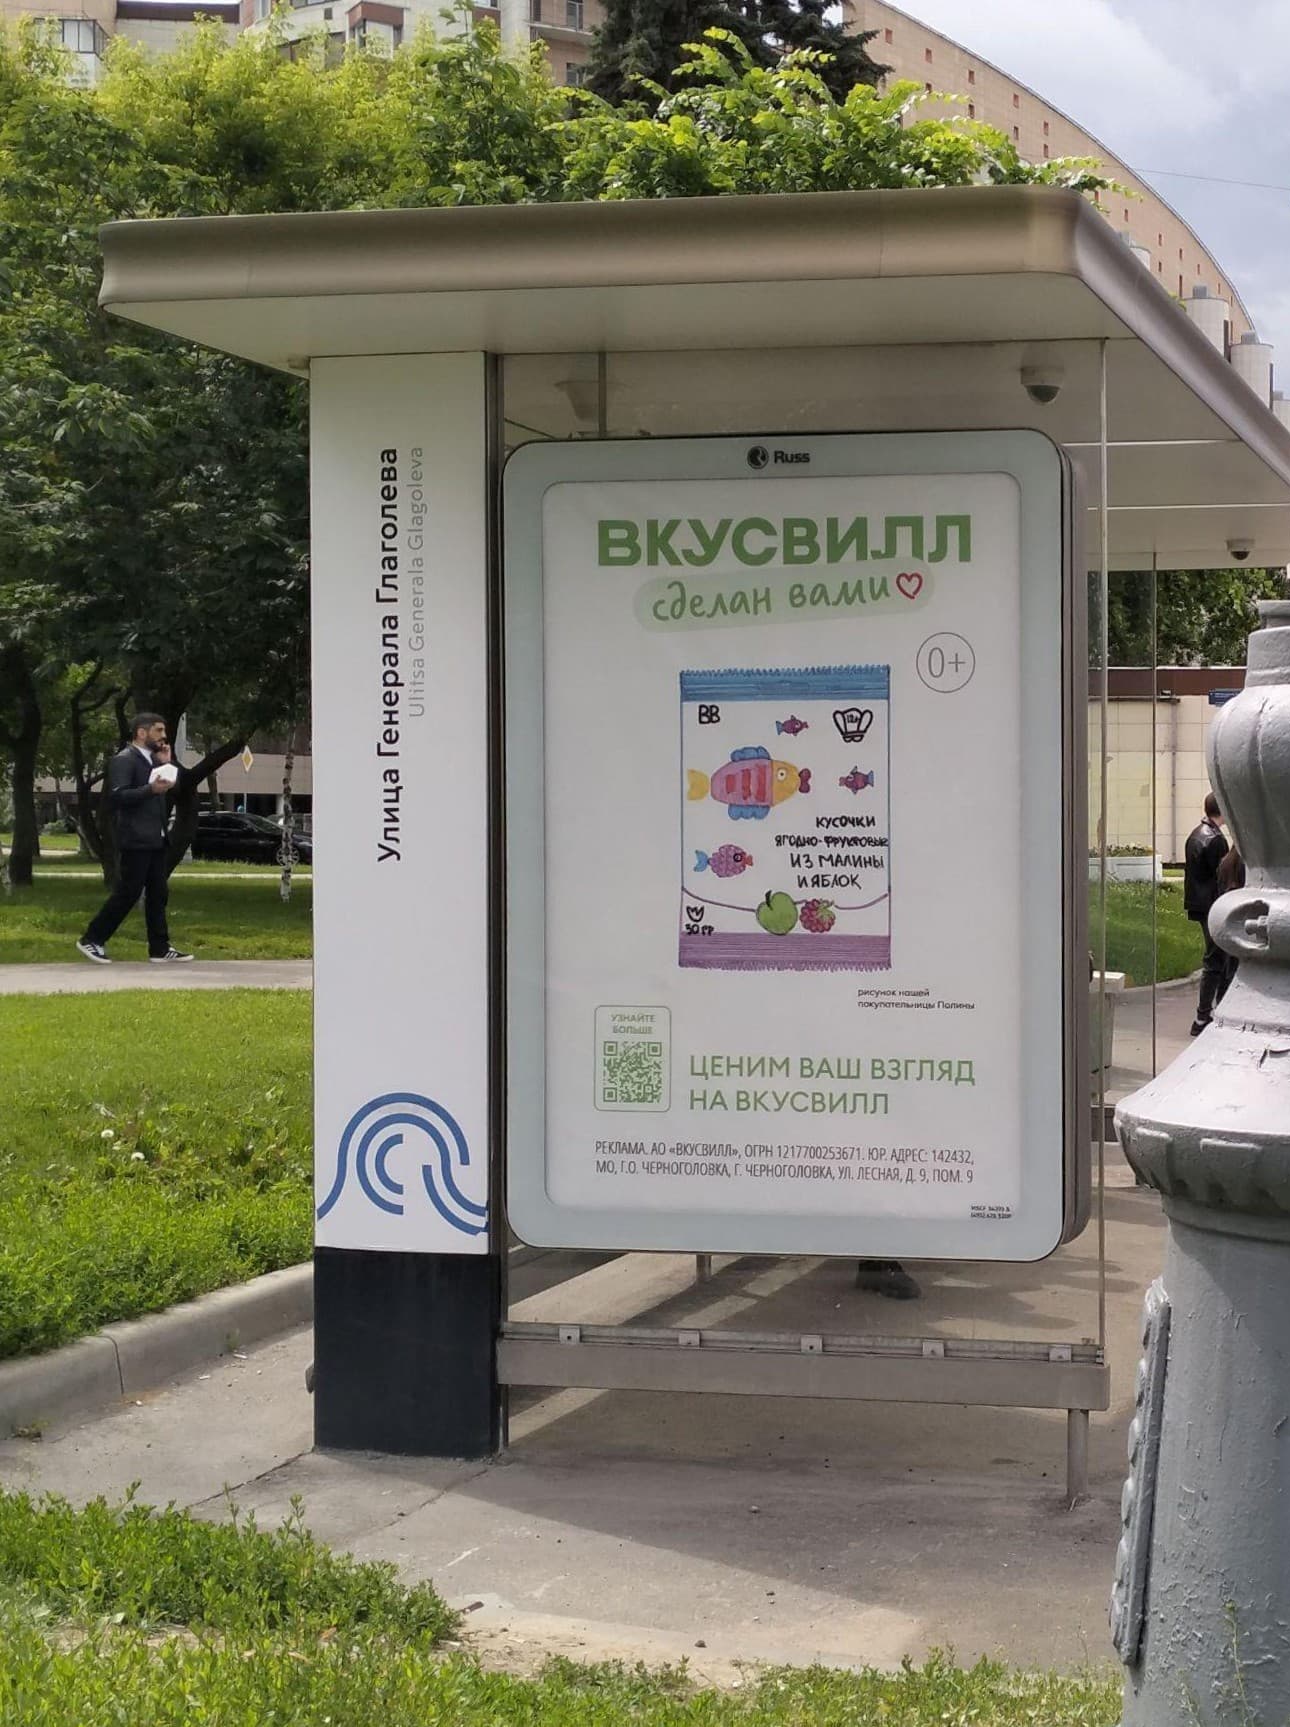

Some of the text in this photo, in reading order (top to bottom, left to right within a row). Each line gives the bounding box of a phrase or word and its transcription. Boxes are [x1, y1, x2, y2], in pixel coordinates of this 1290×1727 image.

[774, 451, 810, 464] Russ
[598, 515, 971, 566] ВКУСВИЛЛ
[407, 447, 427, 717] Ulitsa Generala Glagoleva
[653, 576, 890, 621] сделан вами
[376, 448, 404, 862] Улица Генерала Глаголева
[927, 646, 966, 679] 0+
[816, 816, 875, 829] КУСОЧКИ
[790, 853, 884, 869] ИЗ МАЛИНЫ
[811, 874, 861, 889] ЯБЛОК
[857, 989, 929, 998] рисунок нашей
[857, 1000, 974, 1010] покупательницы Полины
[611, 1013, 655, 1022] УЗНАЙТЕ
[613, 1025, 652, 1034] БОЛЬШЕ
[691, 1056, 975, 1086] ЦЕНИМ ВАШ ВЗГЛЯД
[690, 1089, 888, 1114] НА ВКУСВИЛЛ
[596, 1141, 648, 1155] РЕКЛАМА.
[651, 1142, 666, 1155] АО
[669, 1143, 741, 1159] «ВКУСВИЛЛ»,
[745, 1144, 773, 1157] ОГРН
[777, 1144, 864, 1160] 1217700253671.
[868, 1147, 887, 1161] ЮР.
[932, 1150, 974, 1165] 142432,
[596, 1160, 617, 1175] МО,
[642, 1161, 731, 1178] ЧЕРНОГОЛОВКА,
[746, 1164, 835, 1180] ЧЕРНОГОЛОВКА,
[838, 1166, 853, 1180] УЛ.
[857, 1166, 902, 1183] ЛЕСНАЯ,
[920, 1168, 929, 1184] 9,
[933, 1169, 963, 1183] ПОМ.
[967, 1170, 973, 1183] 9
